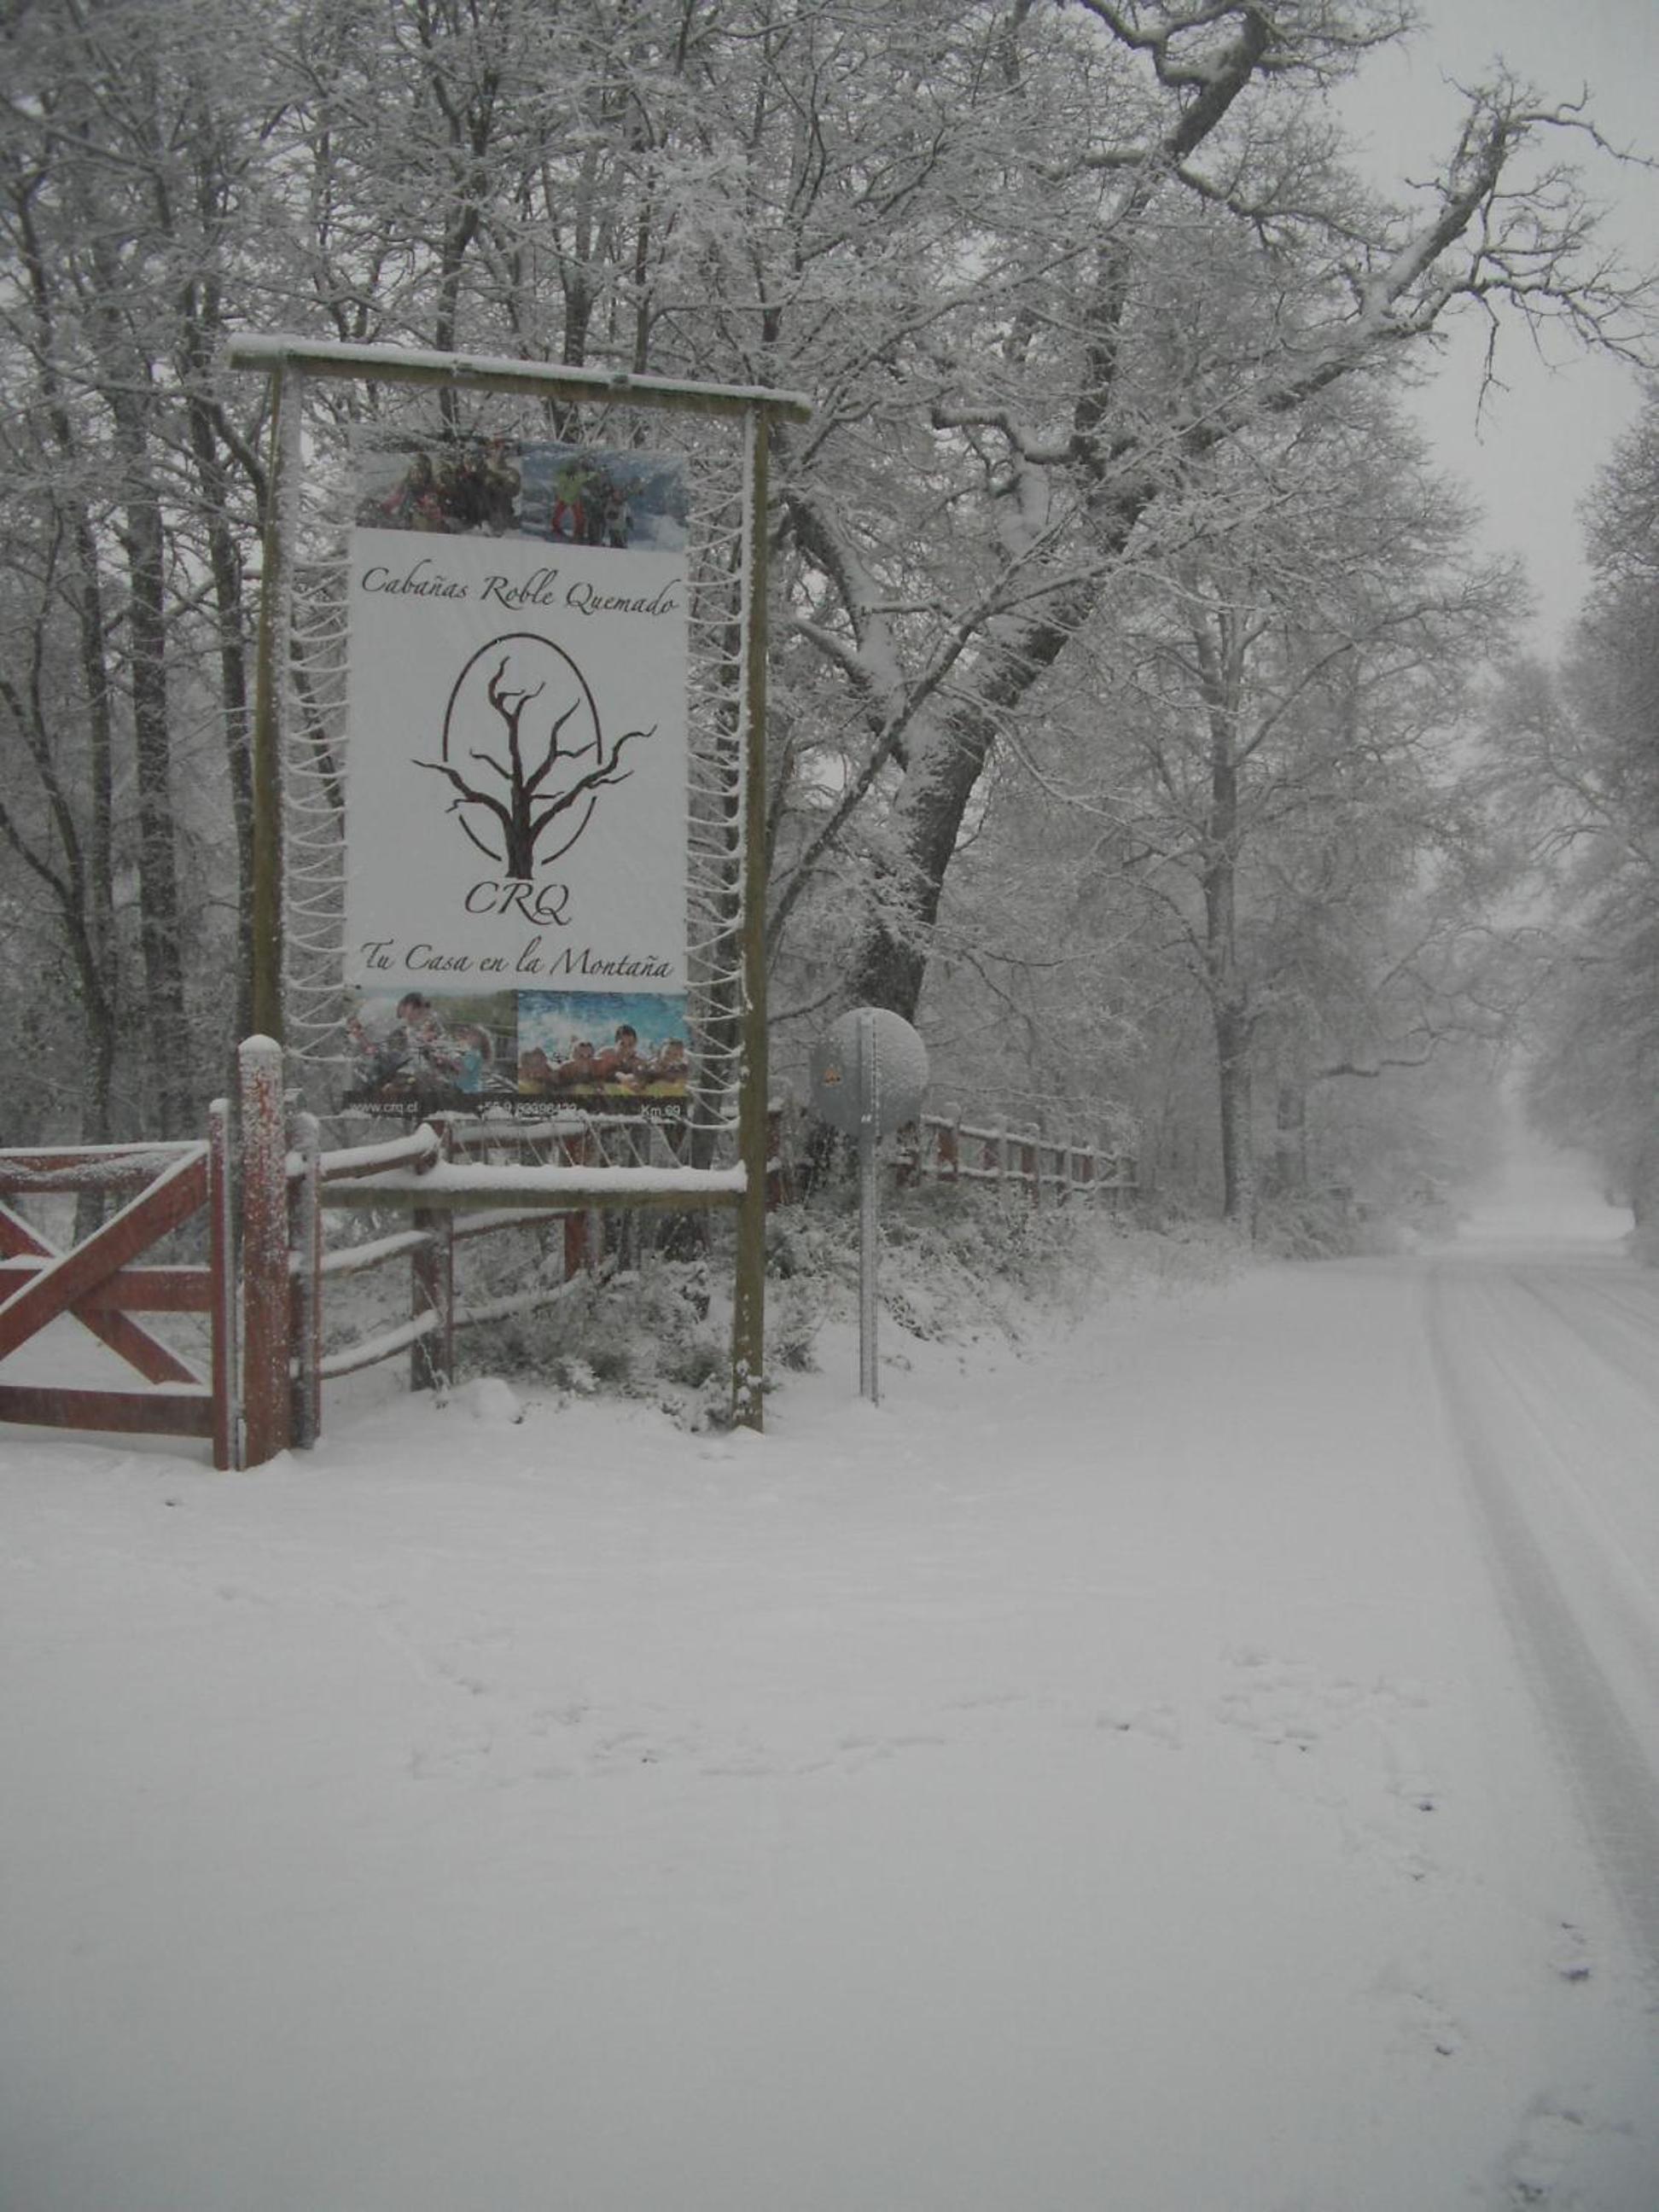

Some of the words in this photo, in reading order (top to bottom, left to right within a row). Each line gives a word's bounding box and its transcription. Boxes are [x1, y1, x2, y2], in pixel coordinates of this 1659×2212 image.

[362, 559, 467, 599] Cabañas
[480, 568, 559, 610] Roble
[567, 579, 681, 615] Quemado
[465, 881, 573, 926] CRQ
[359, 939, 395, 969] Tu
[405, 945, 473, 973] Casa
[480, 957, 509, 973] en
[515, 936, 544, 973] la
[550, 948, 677, 979] Montaña
